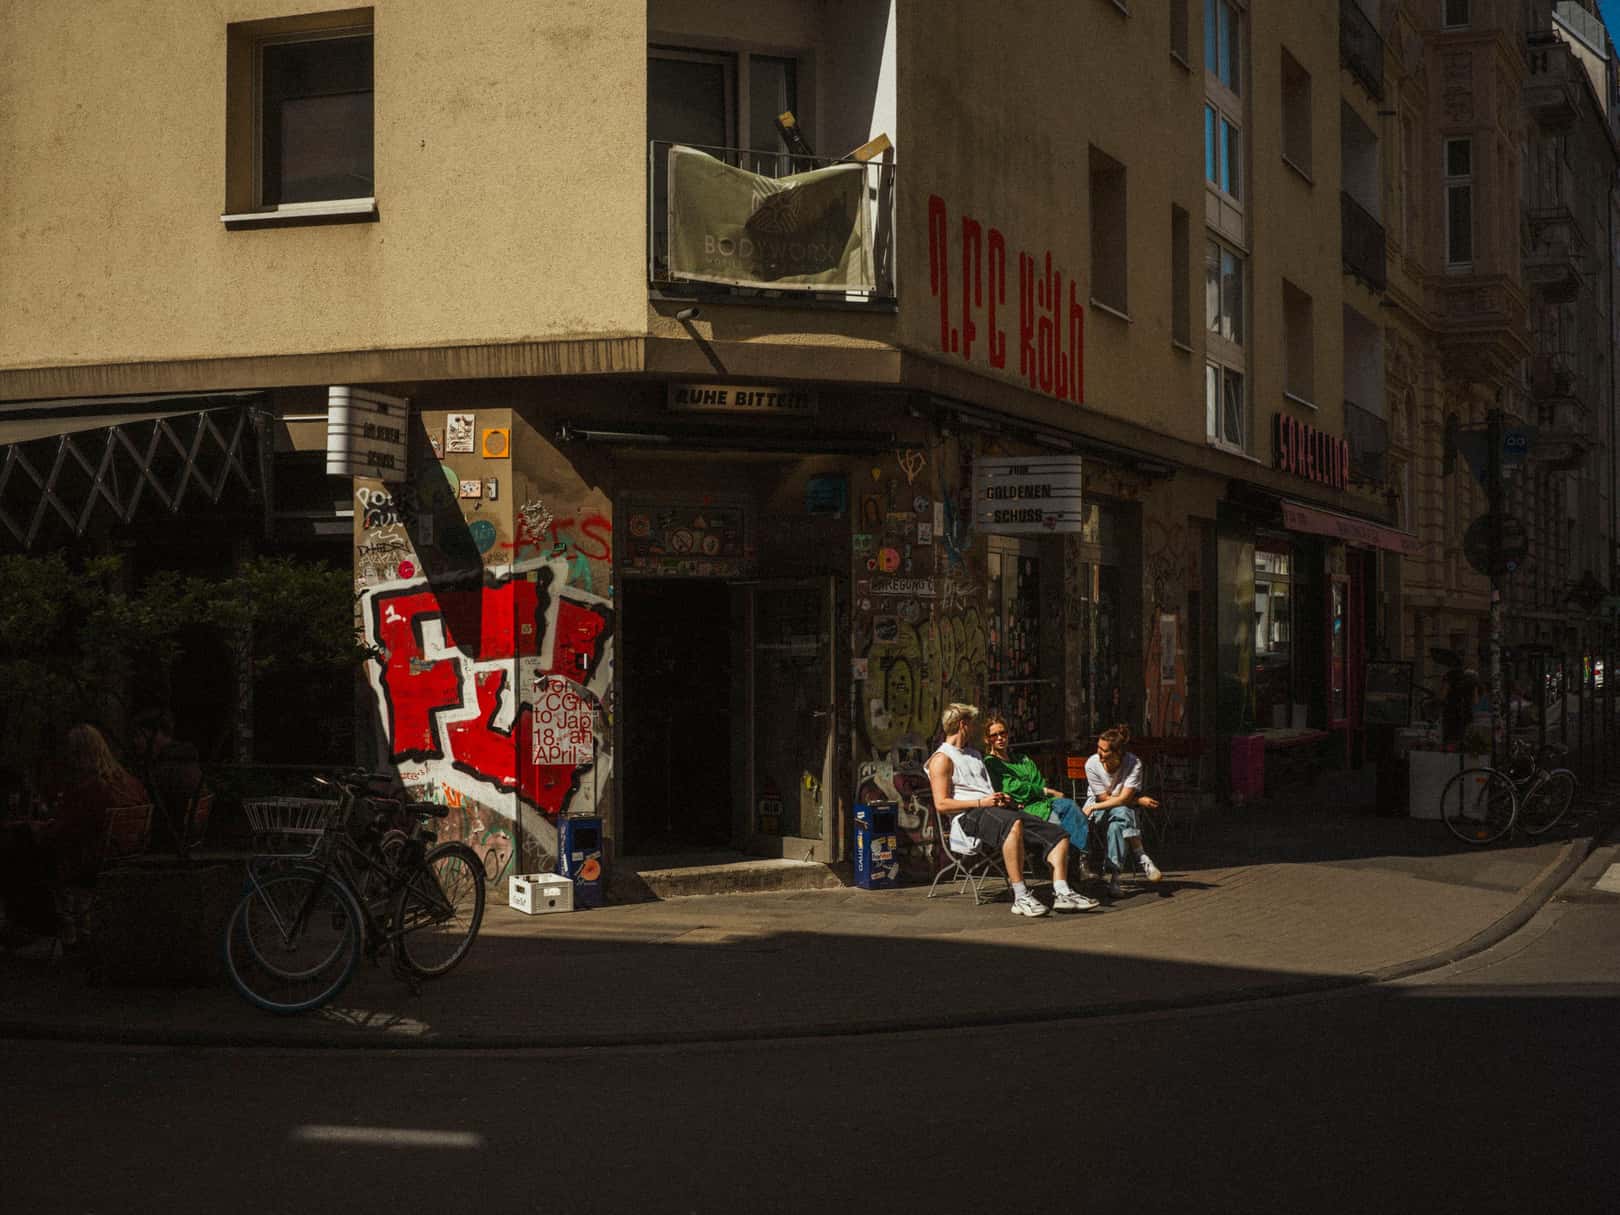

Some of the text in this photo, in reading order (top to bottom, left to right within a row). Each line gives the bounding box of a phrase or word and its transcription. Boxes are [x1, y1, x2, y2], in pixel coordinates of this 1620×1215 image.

[1277, 411, 1349, 490] SORELLINA
[986, 484, 1051, 500] GOLDENEN
[994, 508, 1042, 523] SCHUSS
[546, 692, 592, 712] CGN
[534, 707, 592, 735] to Jap
[533, 728, 592, 746] 18. an
[534, 745, 576, 764] April
